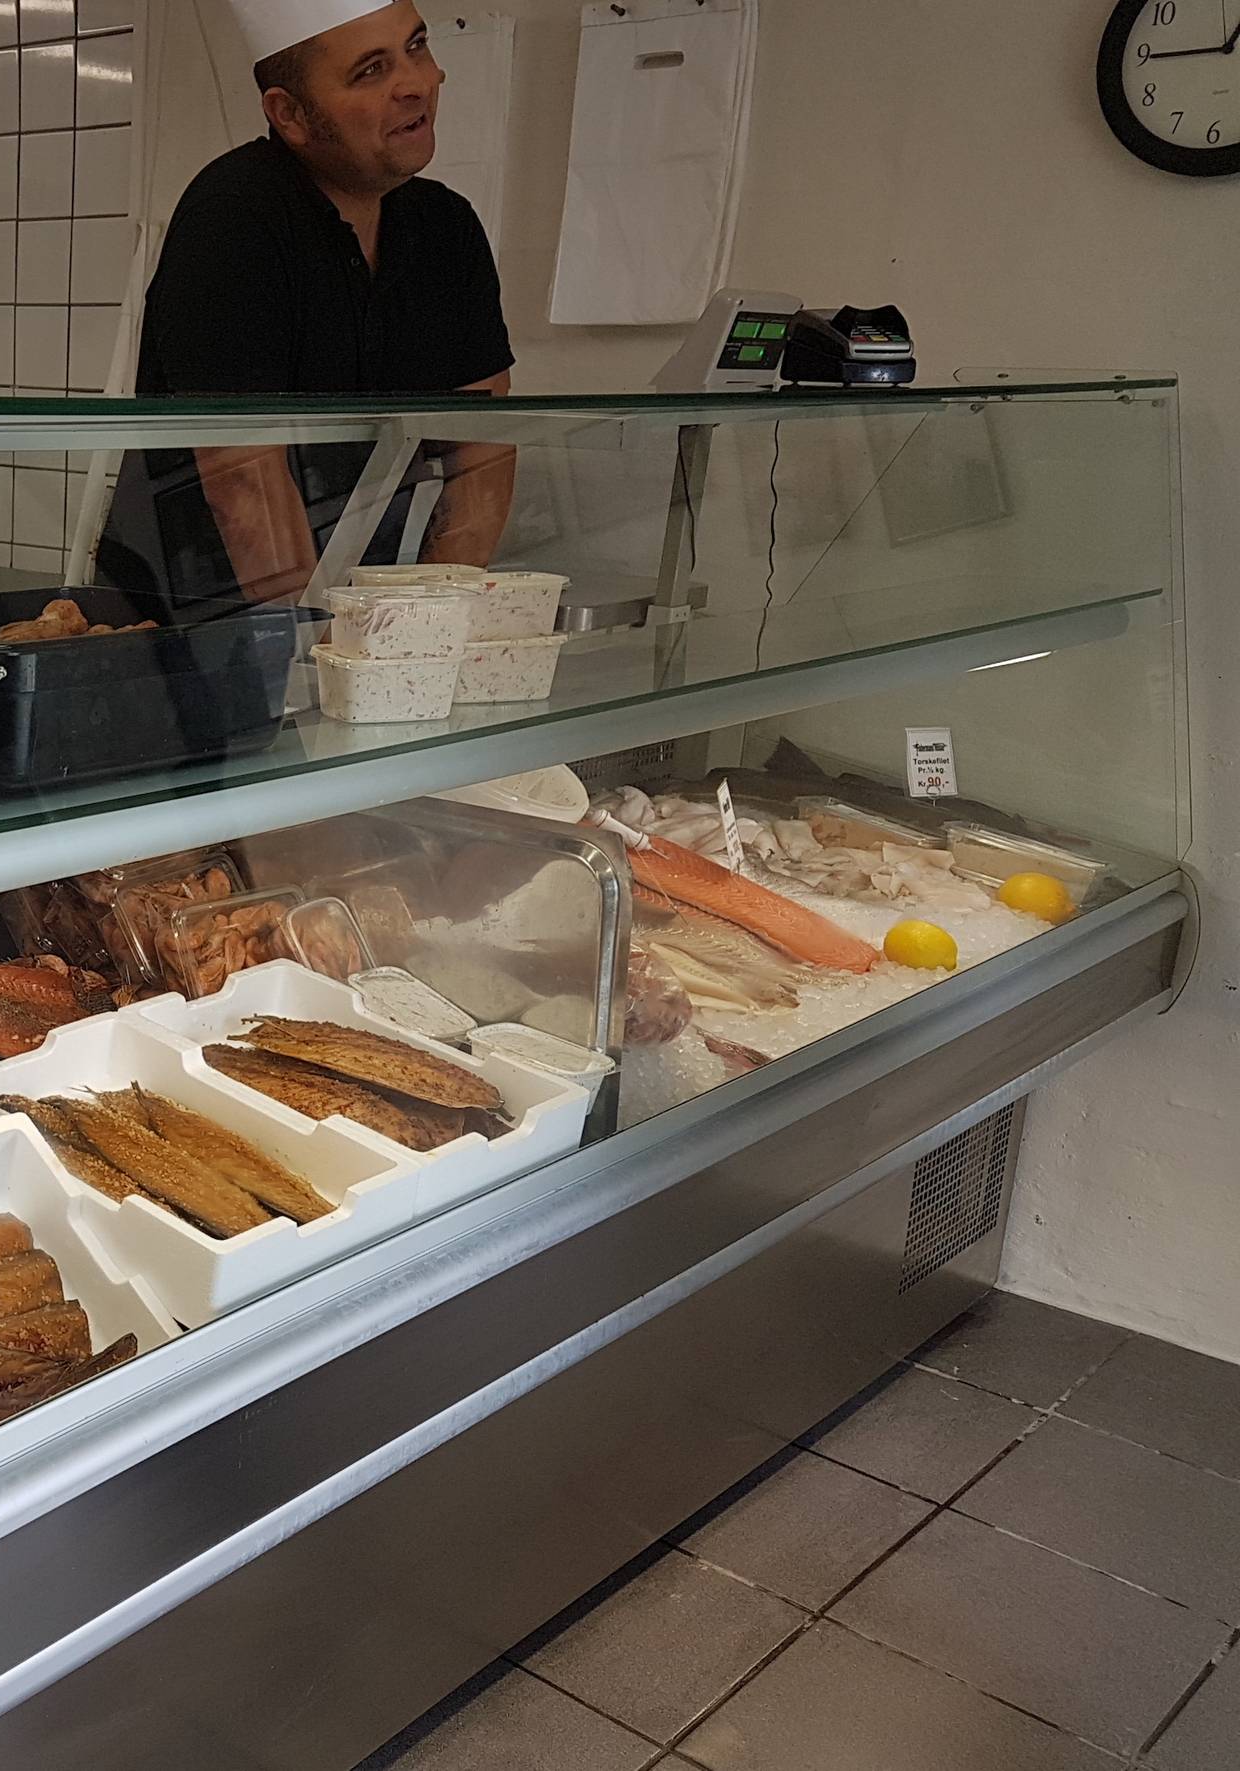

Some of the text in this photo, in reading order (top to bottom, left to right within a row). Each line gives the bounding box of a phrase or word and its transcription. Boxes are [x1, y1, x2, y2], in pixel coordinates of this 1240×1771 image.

[1151, 1, 1176, 26] 10
[1137, 43, 1151, 67] 9
[1142, 83, 1156, 107] 8
[1170, 111, 1184, 134] 7
[1206, 120, 1221, 144] 6
